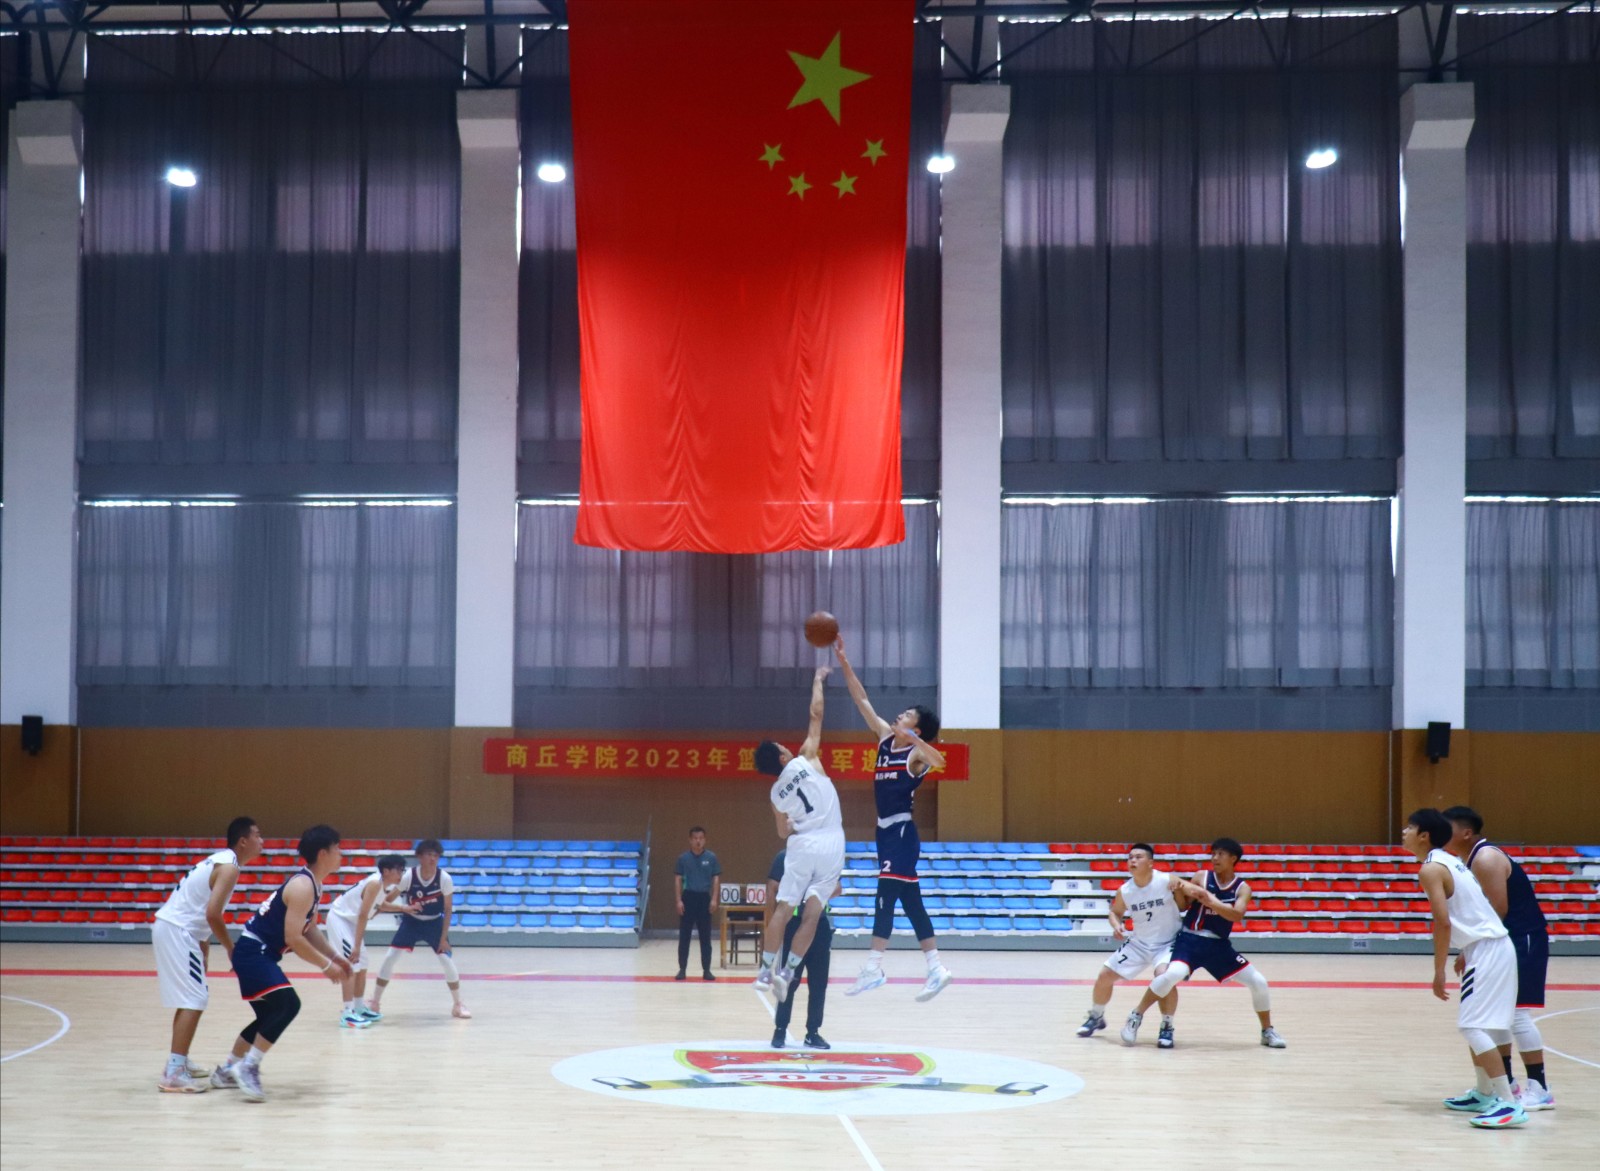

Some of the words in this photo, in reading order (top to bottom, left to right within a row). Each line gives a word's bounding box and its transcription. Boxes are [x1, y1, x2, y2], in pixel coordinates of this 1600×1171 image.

[796, 786, 814, 814] 1
[721, 888, 739, 902] 00
[748, 888, 765, 903] 00
[1146, 911, 1153, 922] 7
[1117, 954, 1128, 964] 7
